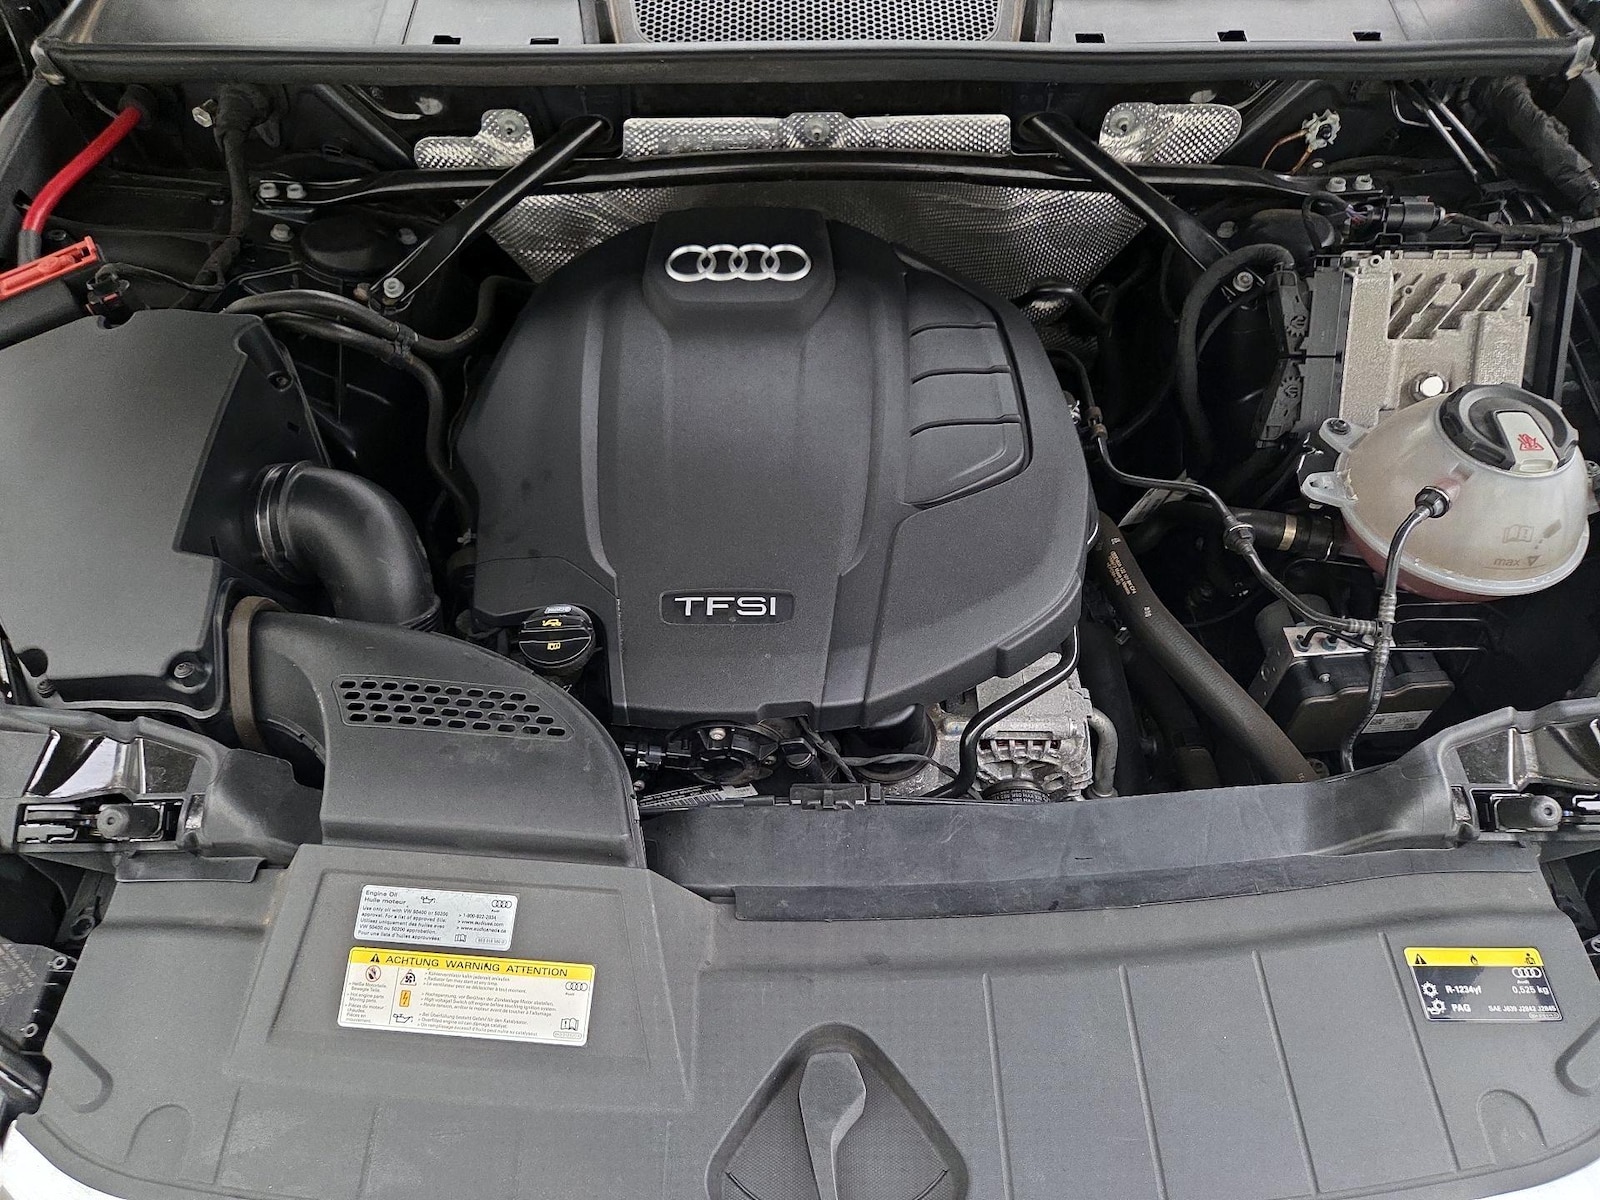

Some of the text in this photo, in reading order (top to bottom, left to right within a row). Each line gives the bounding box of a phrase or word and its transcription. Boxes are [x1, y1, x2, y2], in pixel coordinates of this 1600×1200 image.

[1493, 557, 1520, 567] max
[674, 597, 776, 616] TFSI
[385, 956, 568, 977] ACHTUNG WARNING ATTENTION
[1445, 985, 1482, 995] R-1234yf
[1538, 986, 1549, 995] kg
[1451, 1004, 1471, 1012] PAG
